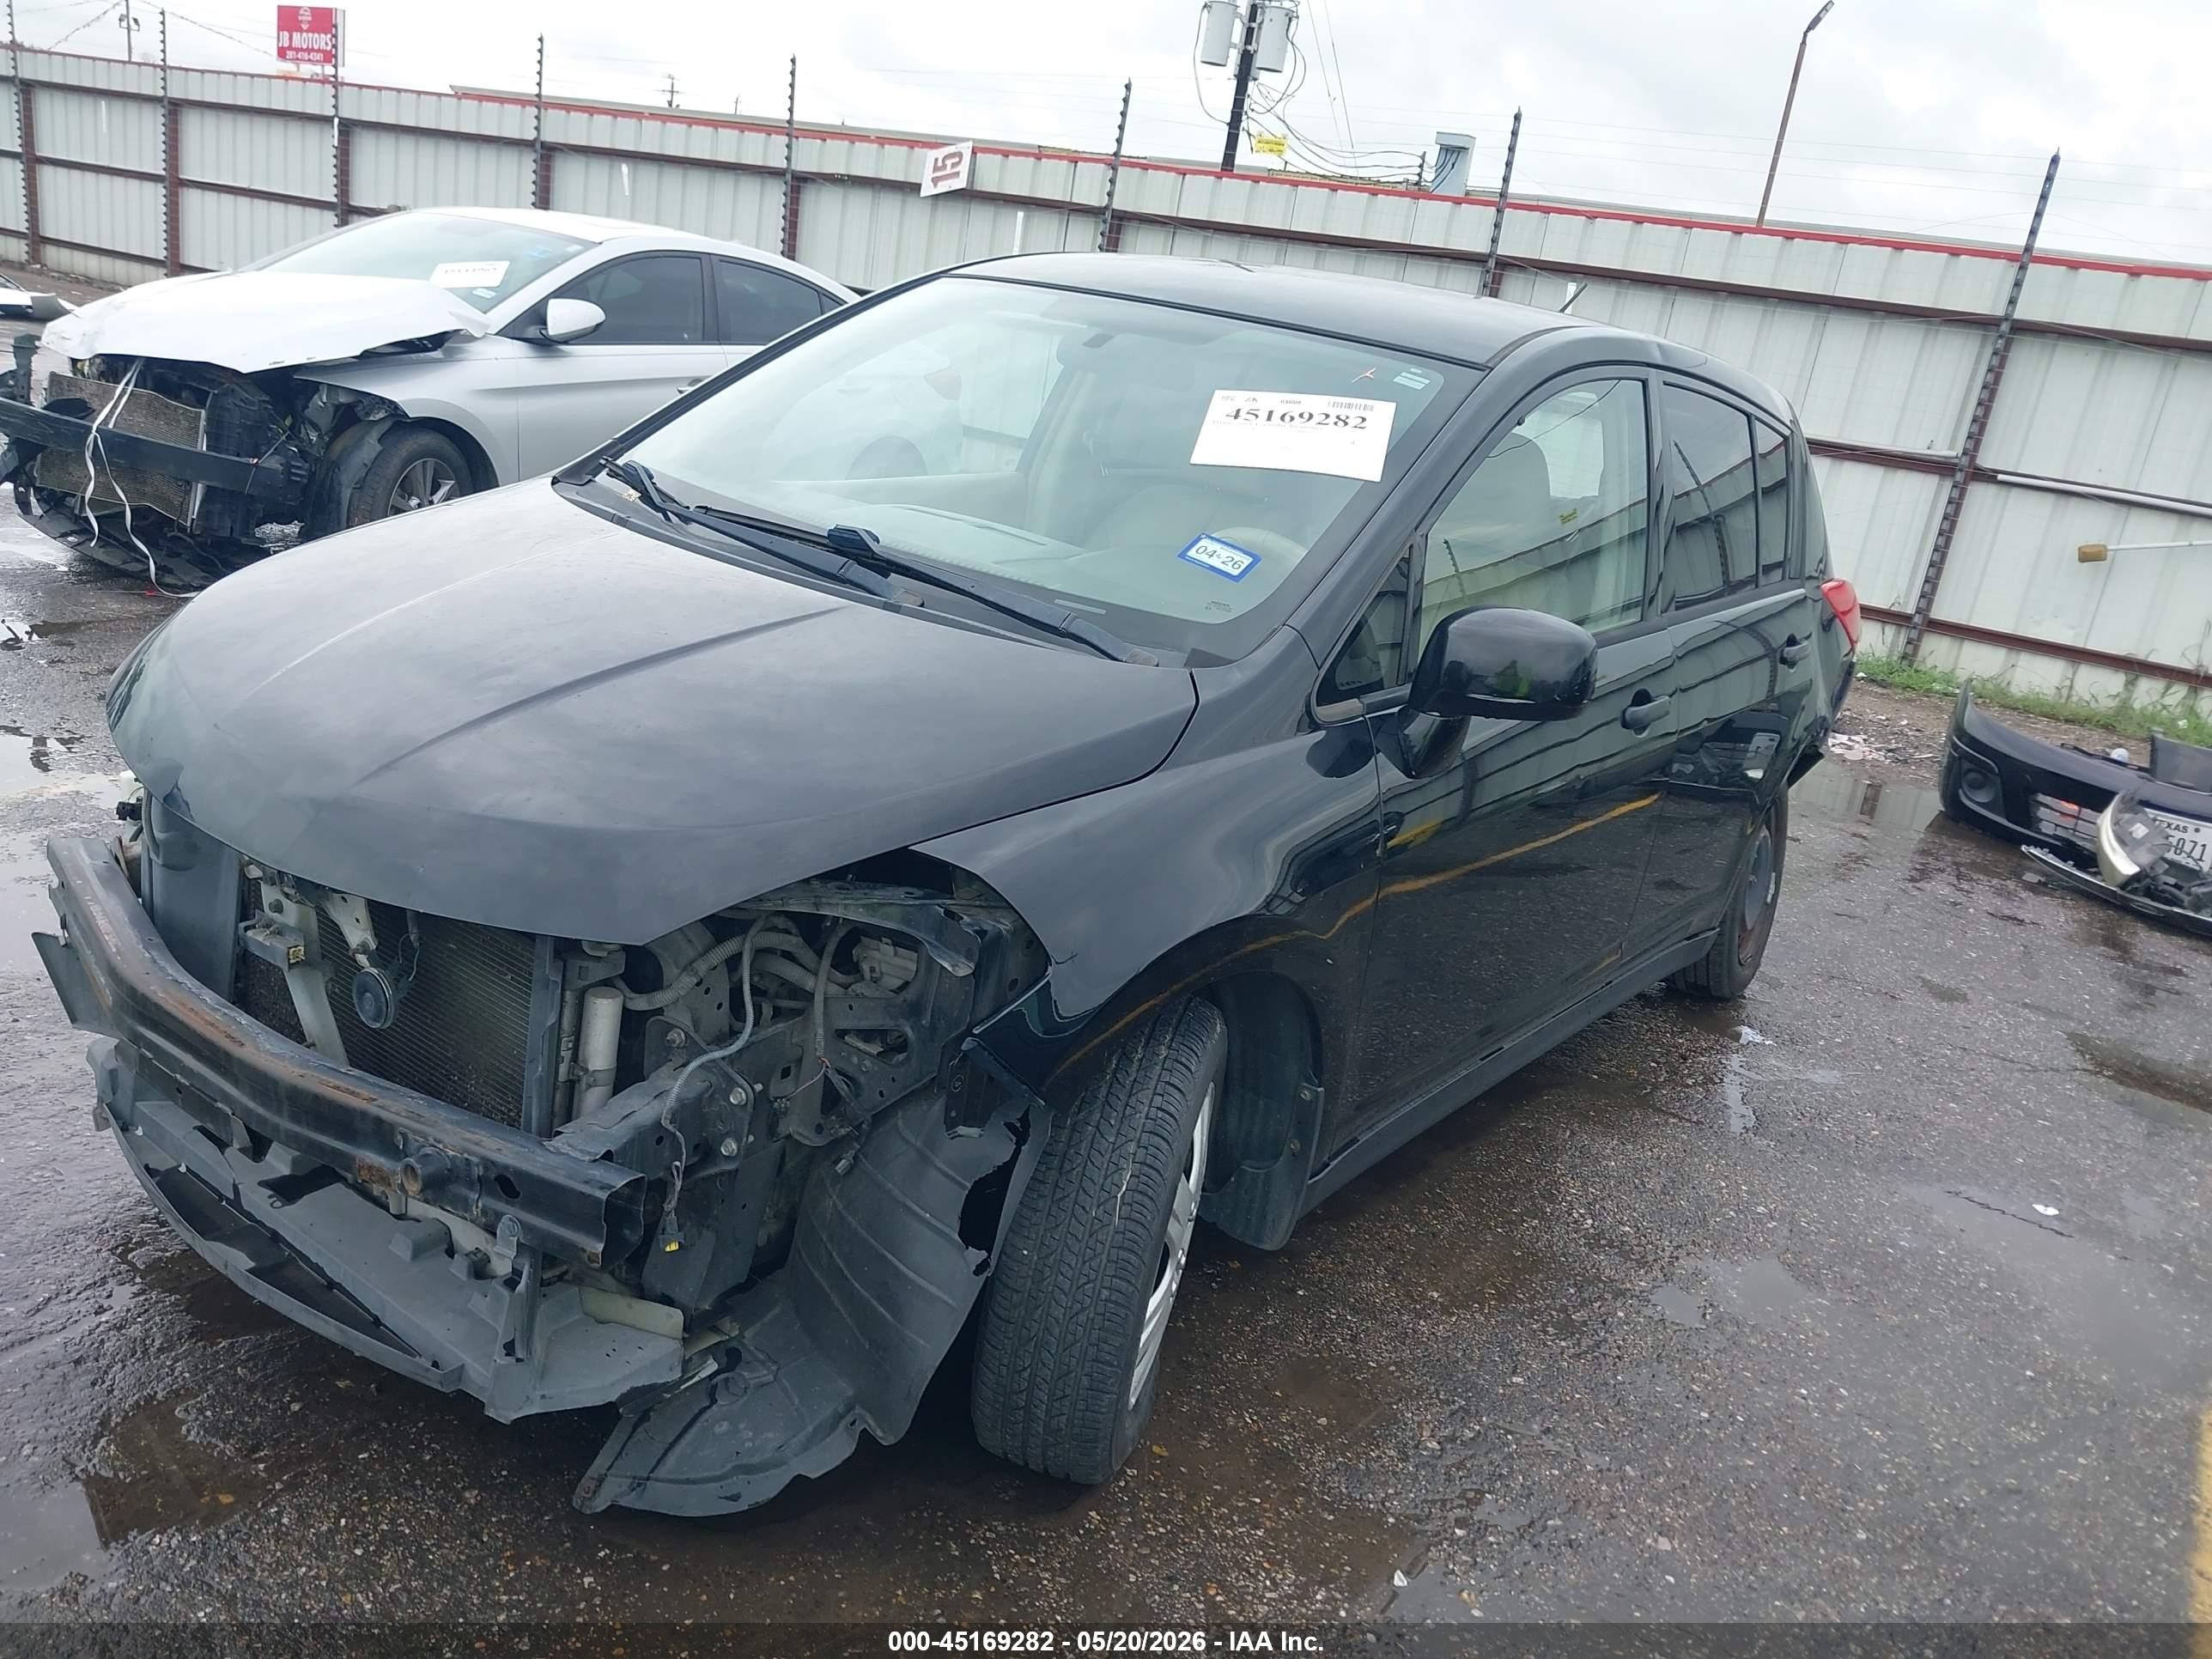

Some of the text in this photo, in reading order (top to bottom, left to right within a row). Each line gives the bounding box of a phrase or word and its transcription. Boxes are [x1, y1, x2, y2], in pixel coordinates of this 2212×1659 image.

[278, 31, 332, 51] JB MOTORS
[931, 150, 964, 190] 15
[1225, 408, 1368, 430] 45169282
[1194, 545, 1218, 559] 04
[1220, 556, 1245, 570] 26
